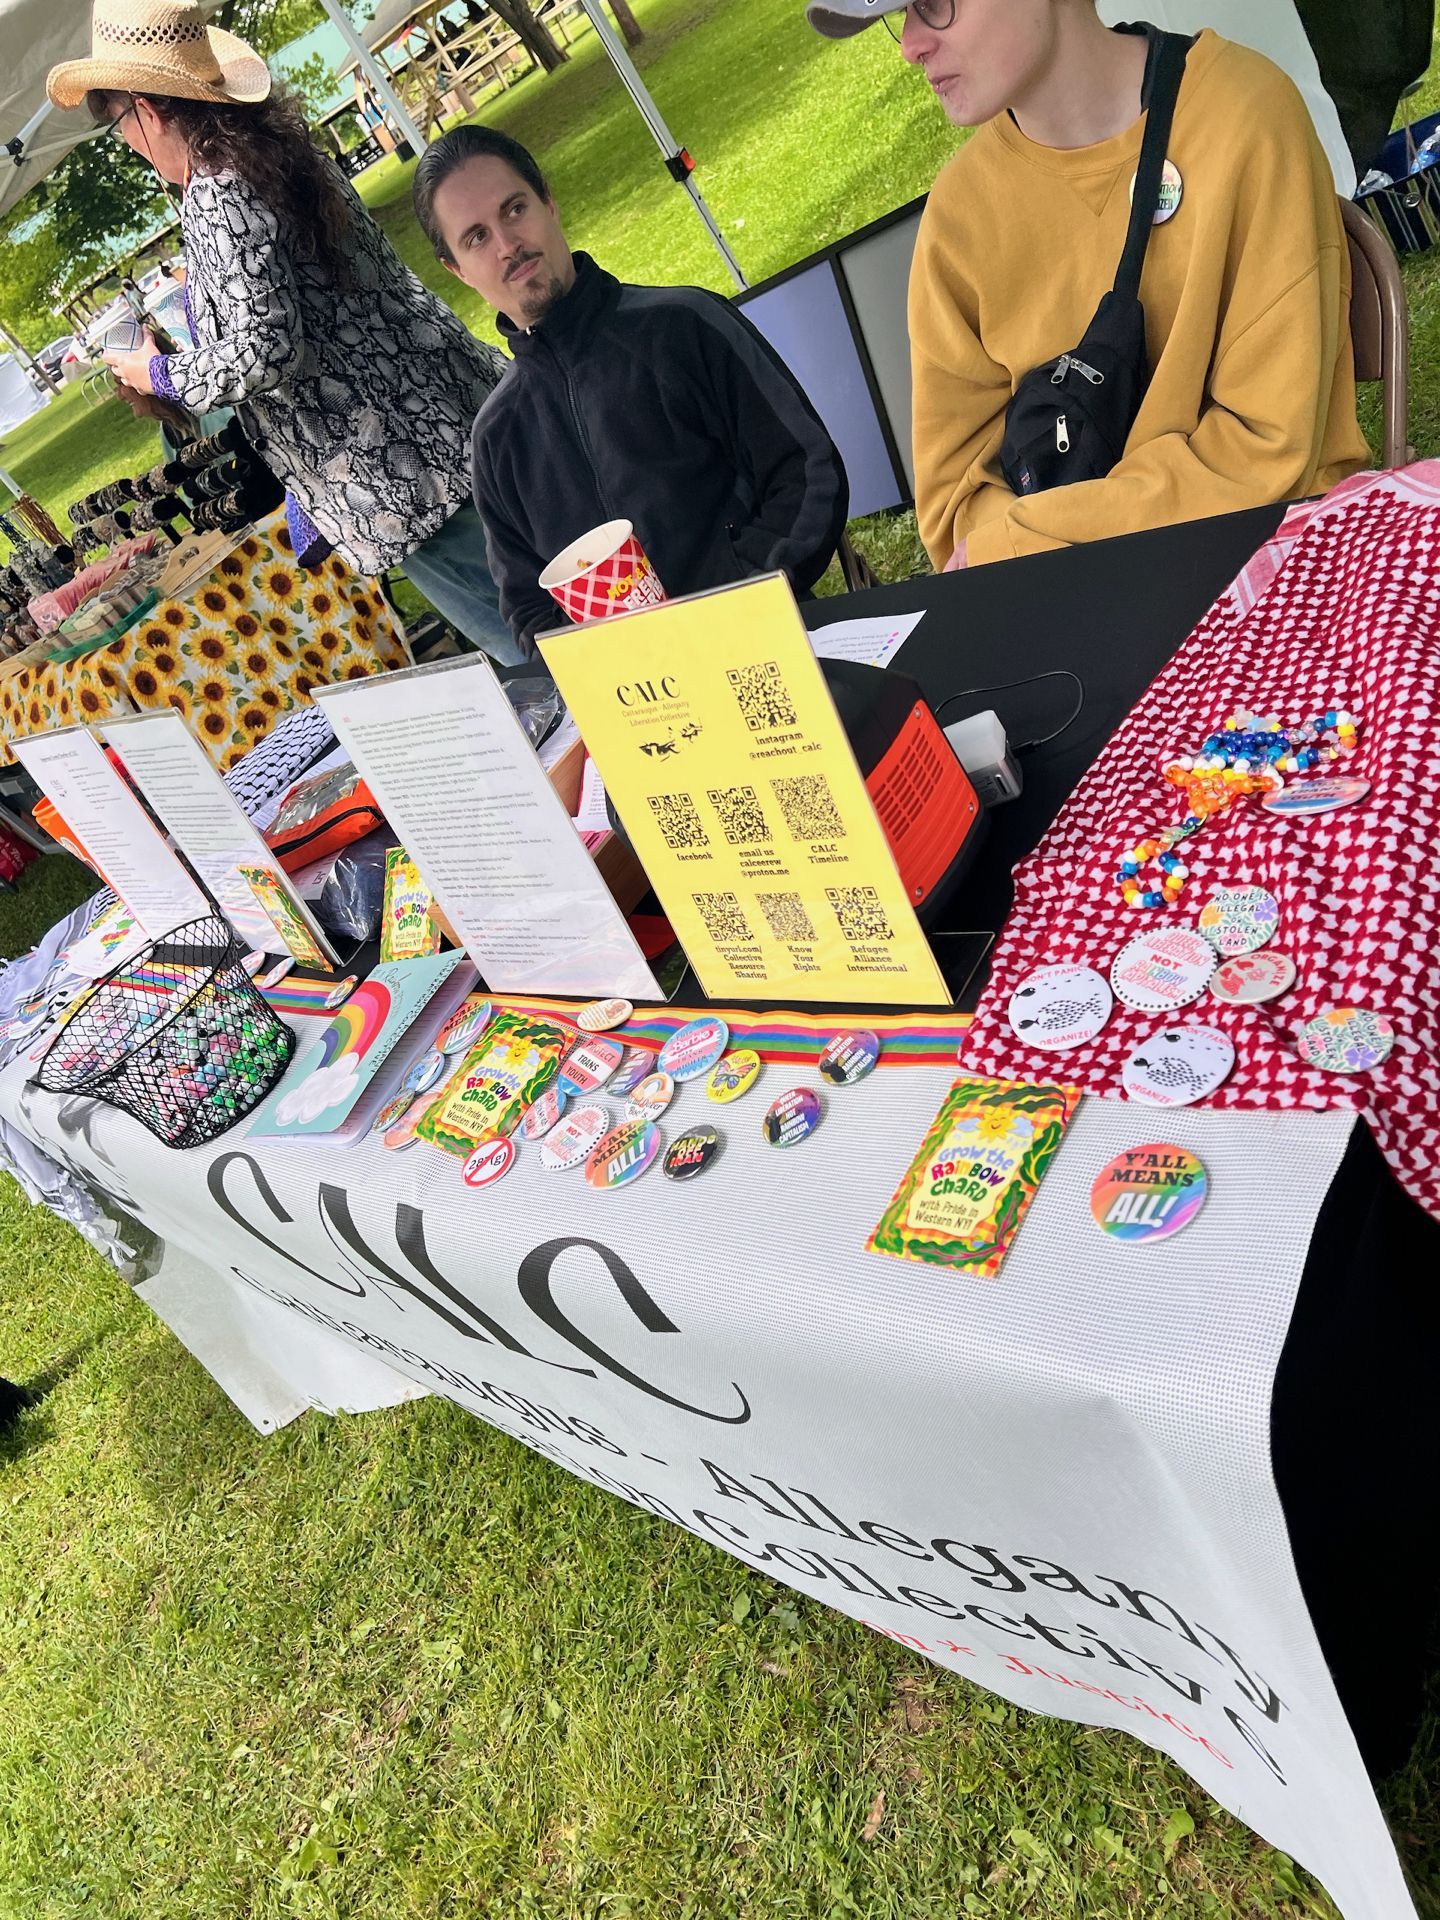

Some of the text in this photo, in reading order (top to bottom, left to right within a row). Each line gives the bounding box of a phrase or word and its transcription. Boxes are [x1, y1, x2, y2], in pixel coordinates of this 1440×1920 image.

[606, 574, 634, 601] HOT
[616, 676, 680, 707] CALC
[755, 731, 804, 746] instagram
[676, 852, 714, 862] facebook
[738, 848, 775, 858] email us
[811, 844, 838, 853] CALC
[807, 855, 850, 864] Timeline
[1214, 893, 1270, 902] NO ONE IS
[1216, 905, 1261, 913] ILLEGAL
[1215, 926, 1258, 935] STOLEN
[787, 945, 813, 953] Know
[850, 945, 889, 954] Refugee
[1219, 938, 1247, 946] LAND
[723, 954, 763, 962] Collective
[728, 962, 766, 970] Resource
[793, 954, 814, 963] Your
[853, 954, 893, 962] Alliance
[1150, 954, 1182, 970] NOT
[735, 971, 768, 980] Sharing
[793, 963, 821, 972] Rights
[847, 964, 908, 972] International
[1250, 953, 1288, 987] ORGANIZE
[672, 1029, 711, 1053] Barbie
[1318, 1027, 1336, 1059] STOLEN
[1346, 1017, 1365, 1052] ILLEGAL
[586, 1041, 616, 1062] PROTECT
[1305, 1034, 1320, 1056] LAND
[577, 1055, 600, 1072] TRANS
[474, 1066, 521, 1090] Grow the
[566, 1066, 588, 1085] YOUTH
[451, 1102, 466, 1112] with
[466, 1106, 482, 1120] Pride
[446, 1110, 484, 1132] Western NY!
[566, 1125, 583, 1138] NOT
[594, 1123, 637, 1155] Y'ALL
[592, 1124, 648, 1168] MEANS
[607, 1138, 647, 1183] ALL!
[669, 1151, 704, 1168] IRAN
[938, 1145, 1015, 1171] Grow the
[1125, 1153, 1189, 1170] Y'ALL
[1109, 1168, 1195, 1188] MEANS
[919, 1200, 942, 1212] with
[943, 1202, 969, 1215] Pride
[1104, 1192, 1179, 1228] ALL!
[914, 1210, 973, 1230] Western NY!
[207, 1152, 751, 1425] CALC
[699, 1457, 1290, 1724] Allegany
[692, 1508, 1287, 1787] Collective
[998, 1653, 1235, 1770] Justice
